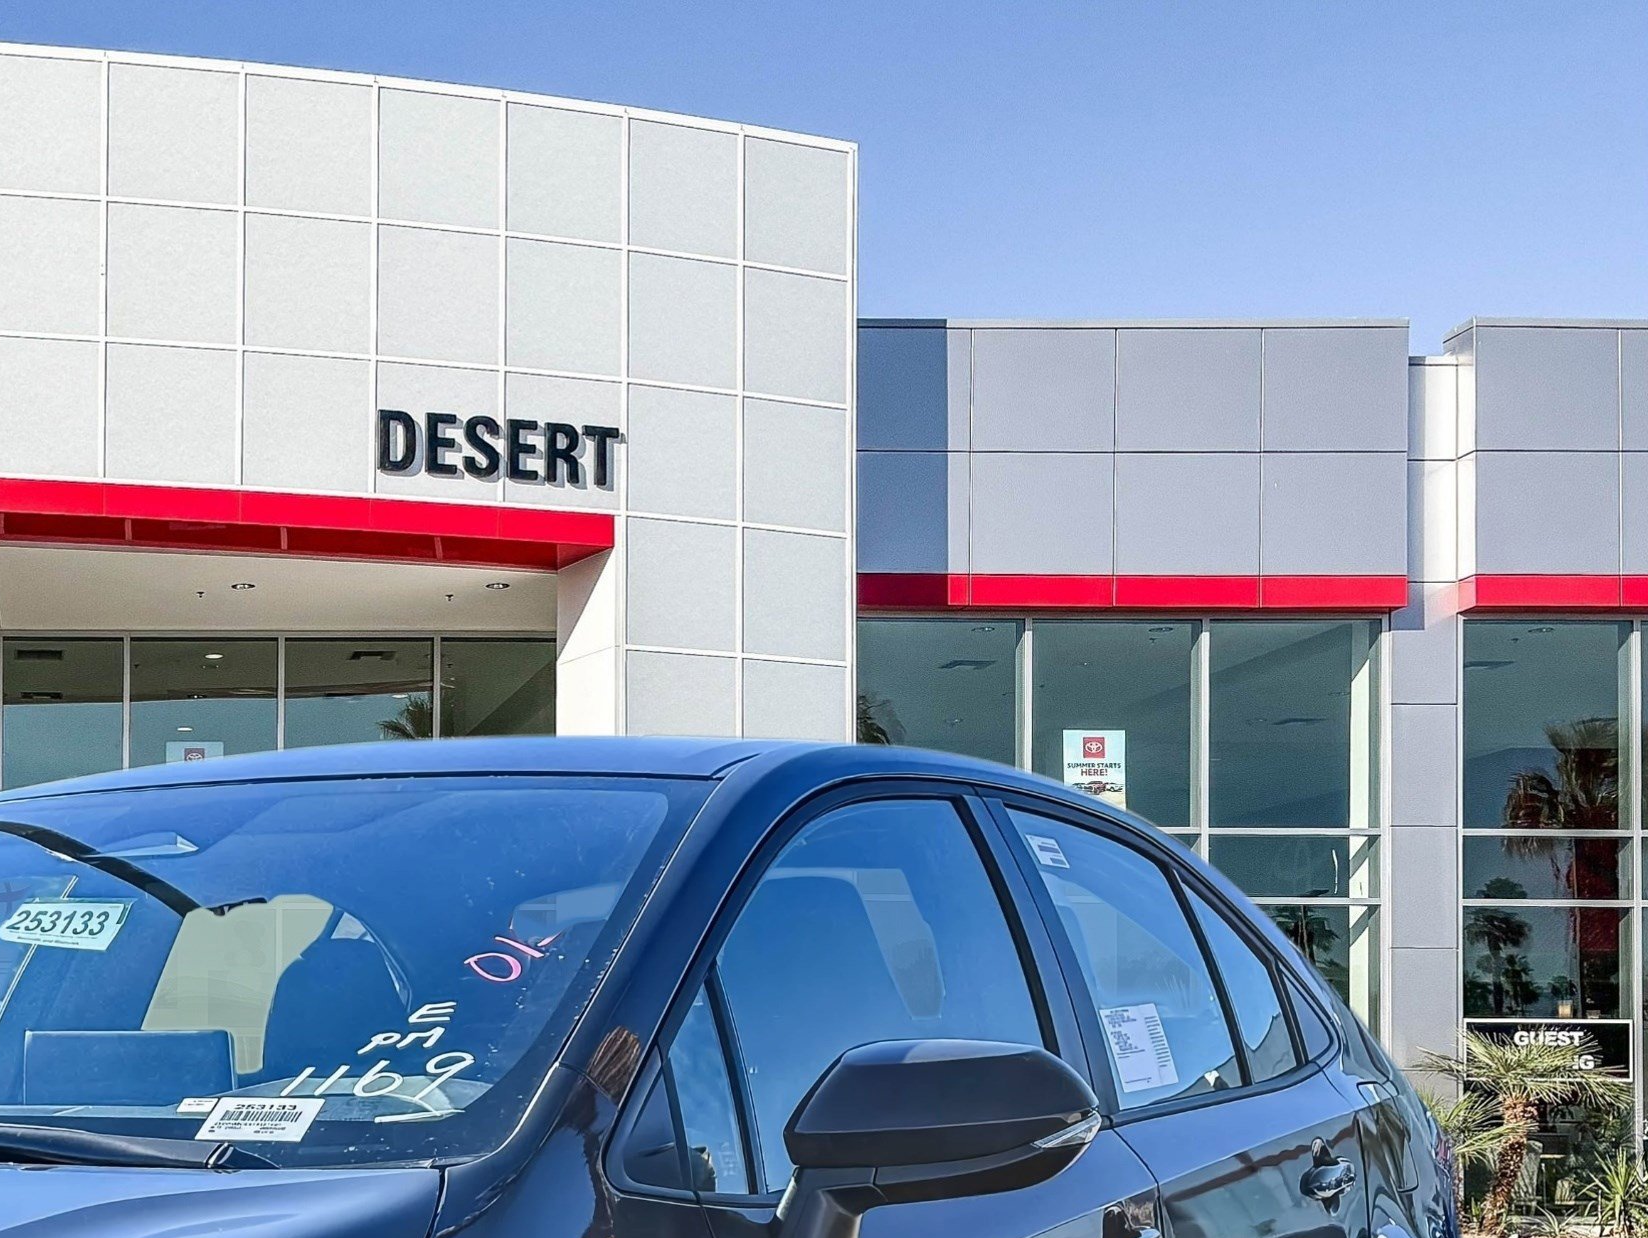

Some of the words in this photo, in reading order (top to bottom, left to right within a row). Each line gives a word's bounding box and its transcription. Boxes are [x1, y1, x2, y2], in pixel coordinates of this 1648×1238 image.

[377, 409, 620, 487] DESERT
[6, 910, 110, 936] 253133
[1513, 1031, 1584, 1047] GUEST
